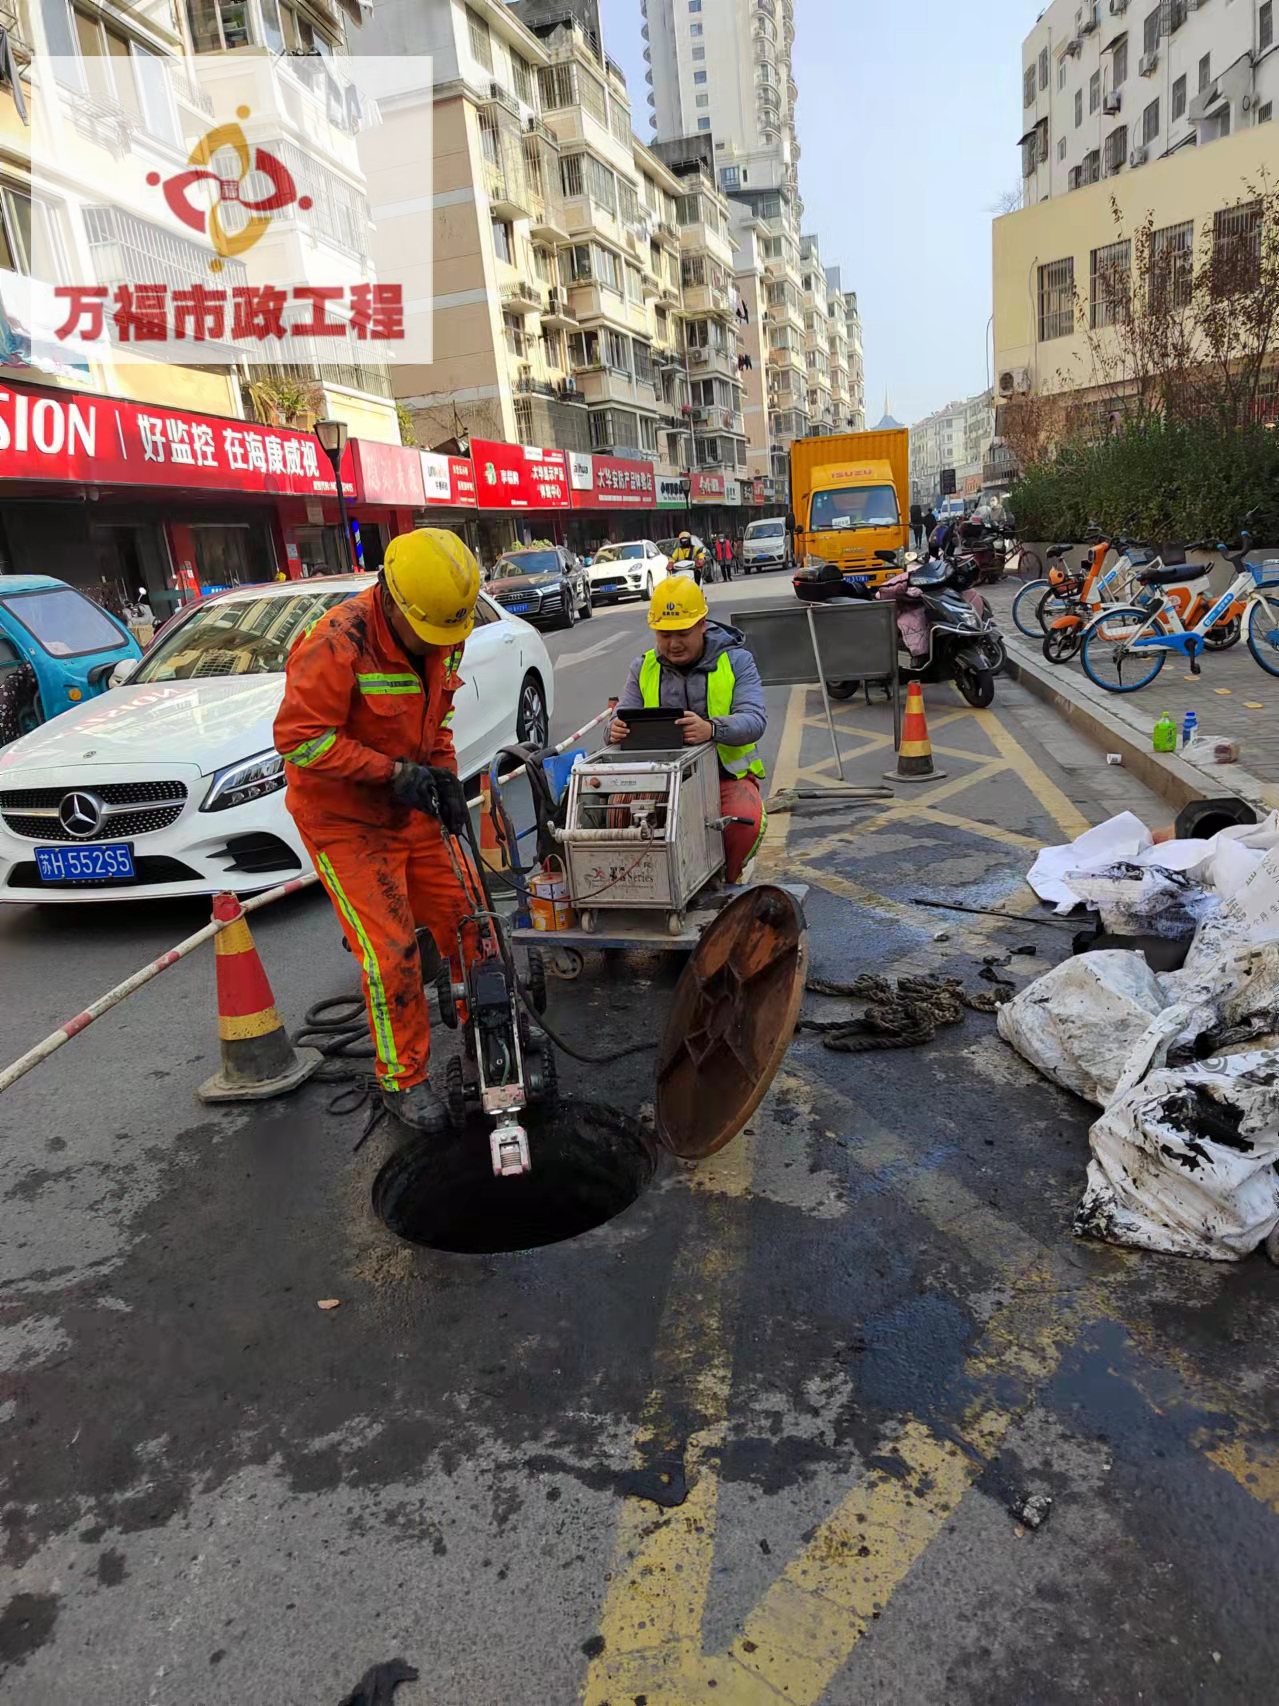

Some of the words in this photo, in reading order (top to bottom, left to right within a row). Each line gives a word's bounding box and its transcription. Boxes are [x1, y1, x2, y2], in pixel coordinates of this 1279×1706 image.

[137, 413, 219, 468] 好监控
[223, 427, 320, 478] 在海康威视
[831, 468, 873, 479] ISUZU
